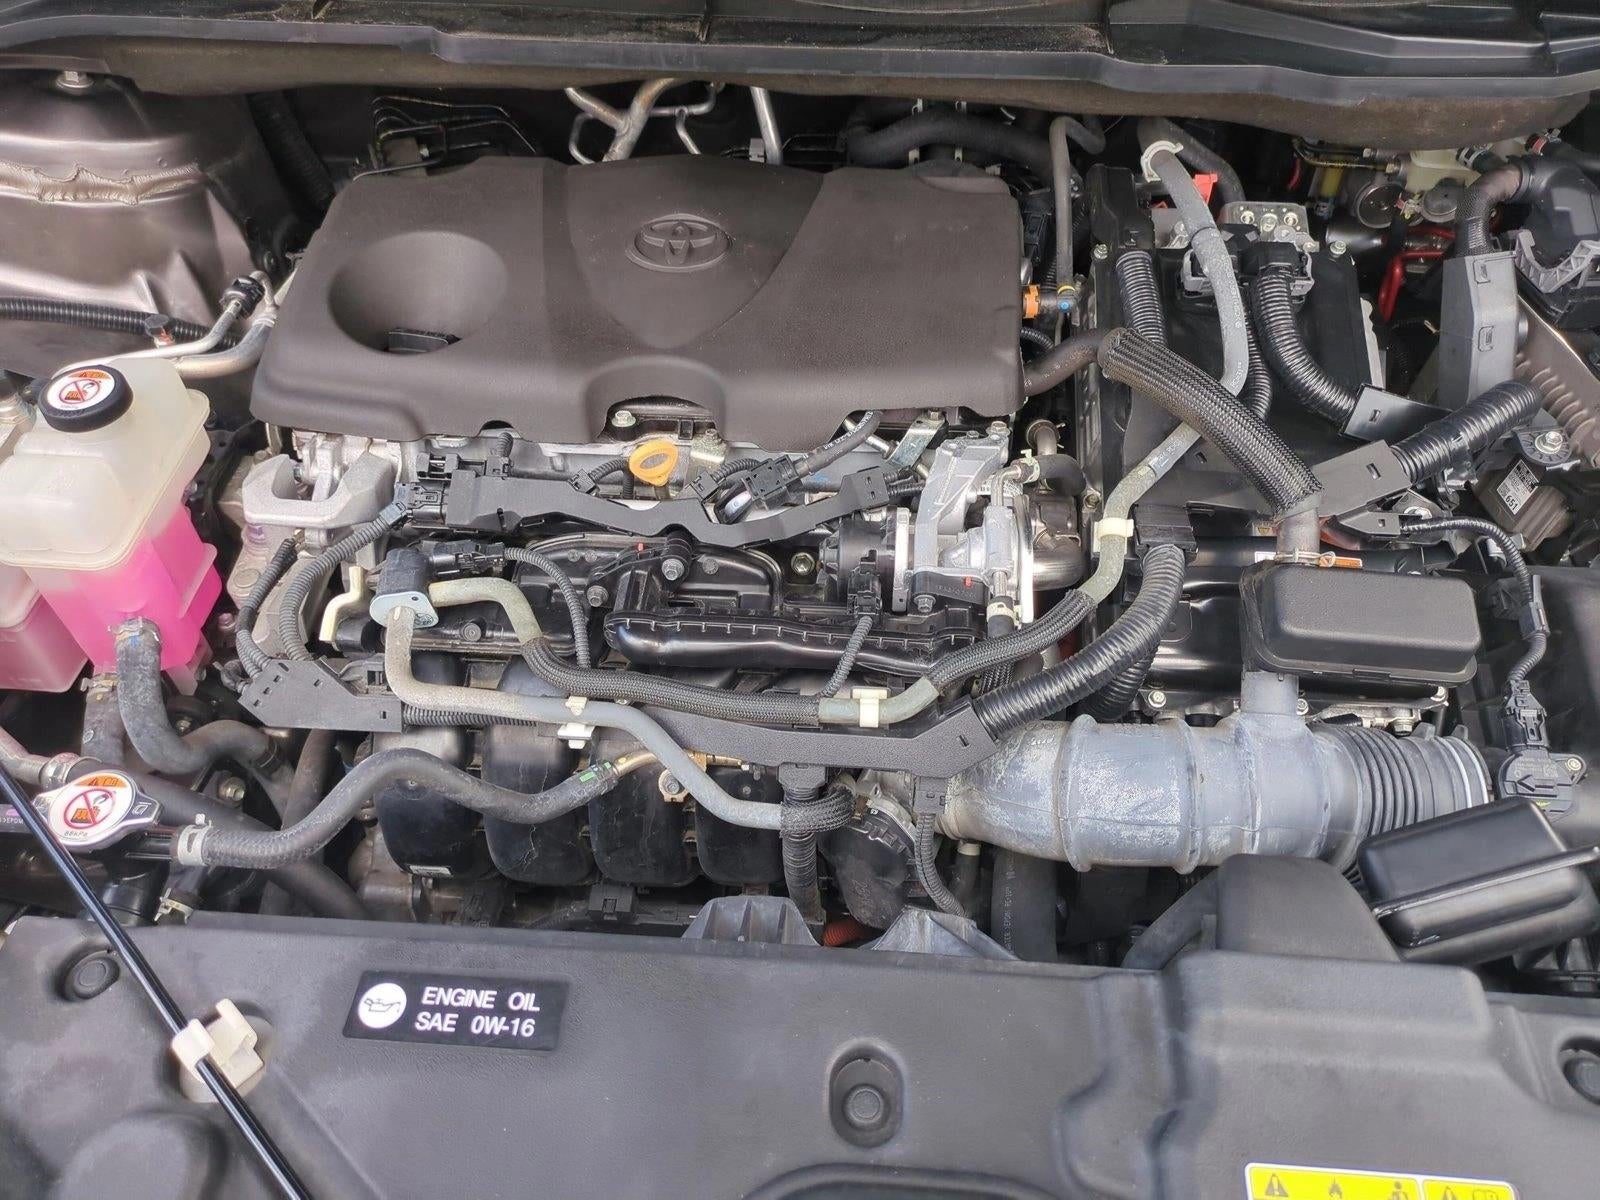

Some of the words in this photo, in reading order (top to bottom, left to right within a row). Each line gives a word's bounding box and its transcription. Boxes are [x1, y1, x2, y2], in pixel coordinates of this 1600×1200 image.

[1505, 495, 1519, 511] 651
[422, 987, 496, 1008] ENGINE
[508, 992, 540, 1012] OIL
[414, 1011, 459, 1033] SAE
[470, 1015, 536, 1038] 0W-16
